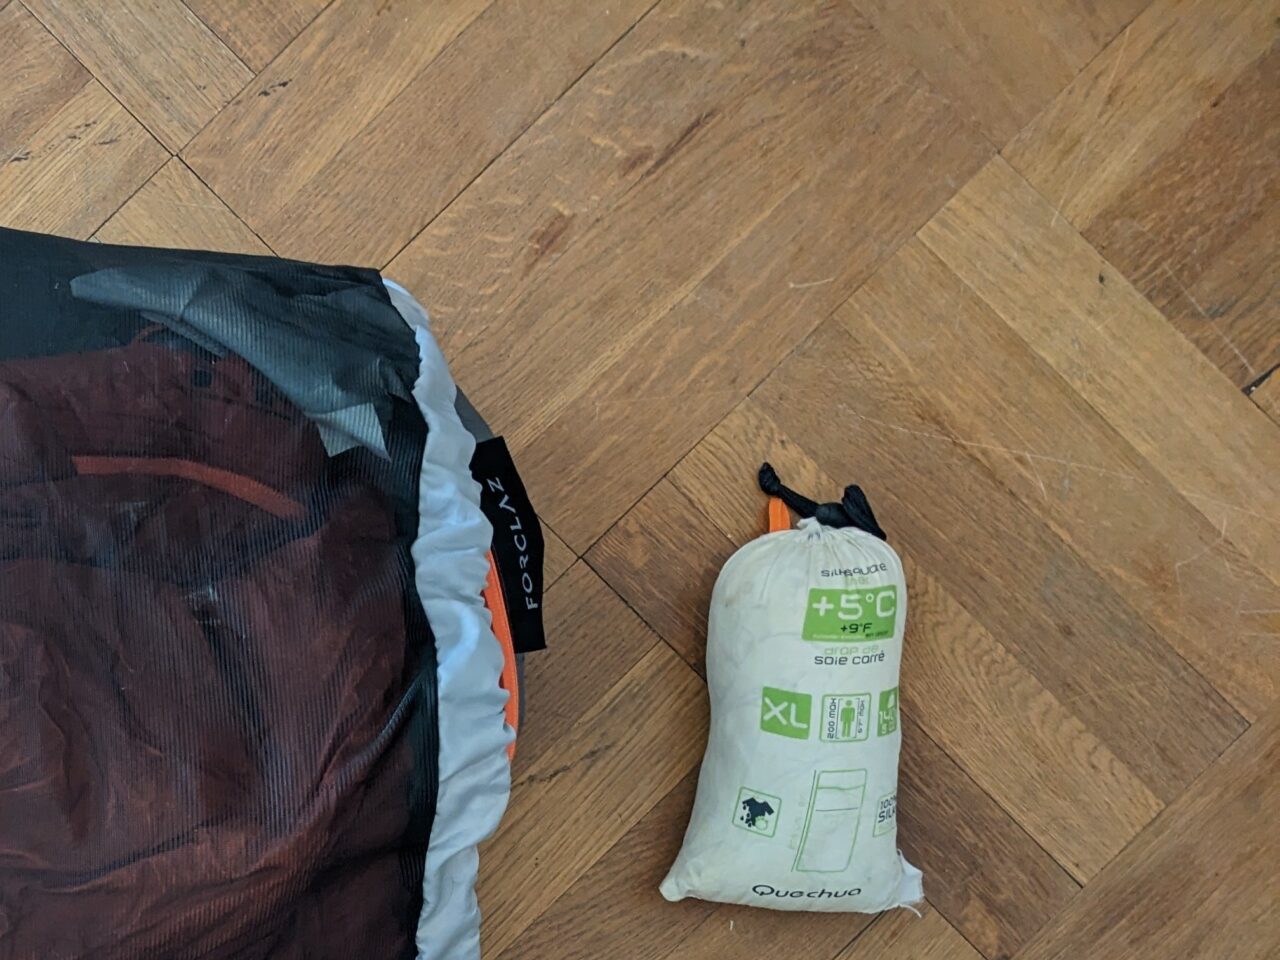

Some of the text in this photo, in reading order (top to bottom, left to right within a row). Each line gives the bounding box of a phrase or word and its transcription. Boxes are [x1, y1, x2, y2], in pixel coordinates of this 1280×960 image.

[486, 477, 538, 609] FORCLAZ
[812, 590, 895, 620] +5°C
[814, 655, 848, 665] soie
[763, 696, 808, 729] XL
[751, 884, 862, 898] Quechua
